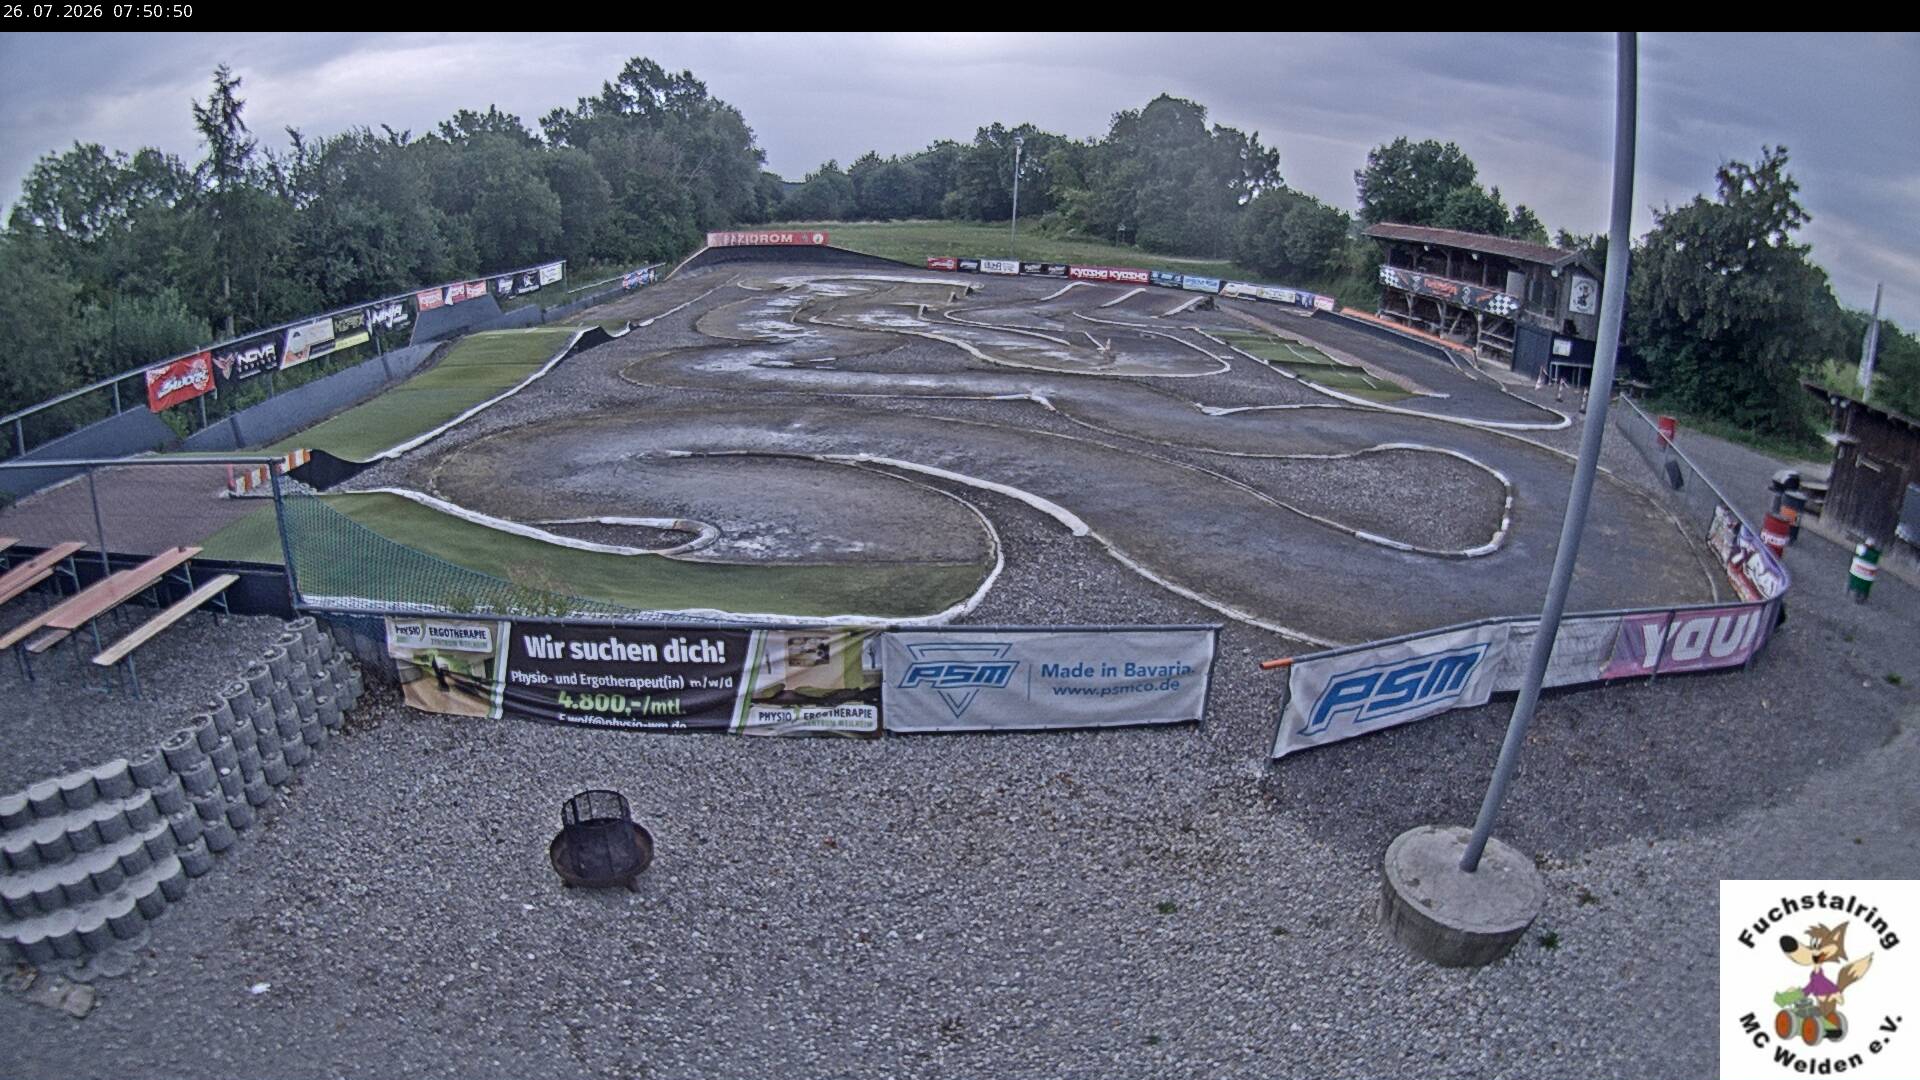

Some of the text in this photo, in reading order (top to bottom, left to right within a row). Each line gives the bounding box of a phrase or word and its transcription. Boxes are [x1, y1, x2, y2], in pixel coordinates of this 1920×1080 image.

[428, 626, 488, 640] ERGOTHERAPIE
[524, 634, 727, 664] Wir suchen dich!
[511, 670, 733, 690] Physio- und Ergotherapeut(in) m/w/d
[904, 663, 1006, 685] PSM
[1041, 663, 1094, 679] Made
[1101, 662, 1117, 679] in
[1052, 679, 1180, 697] www.psmco.de
[1311, 652, 1481, 726] PSM
[759, 711, 792, 721] PHYSIO
